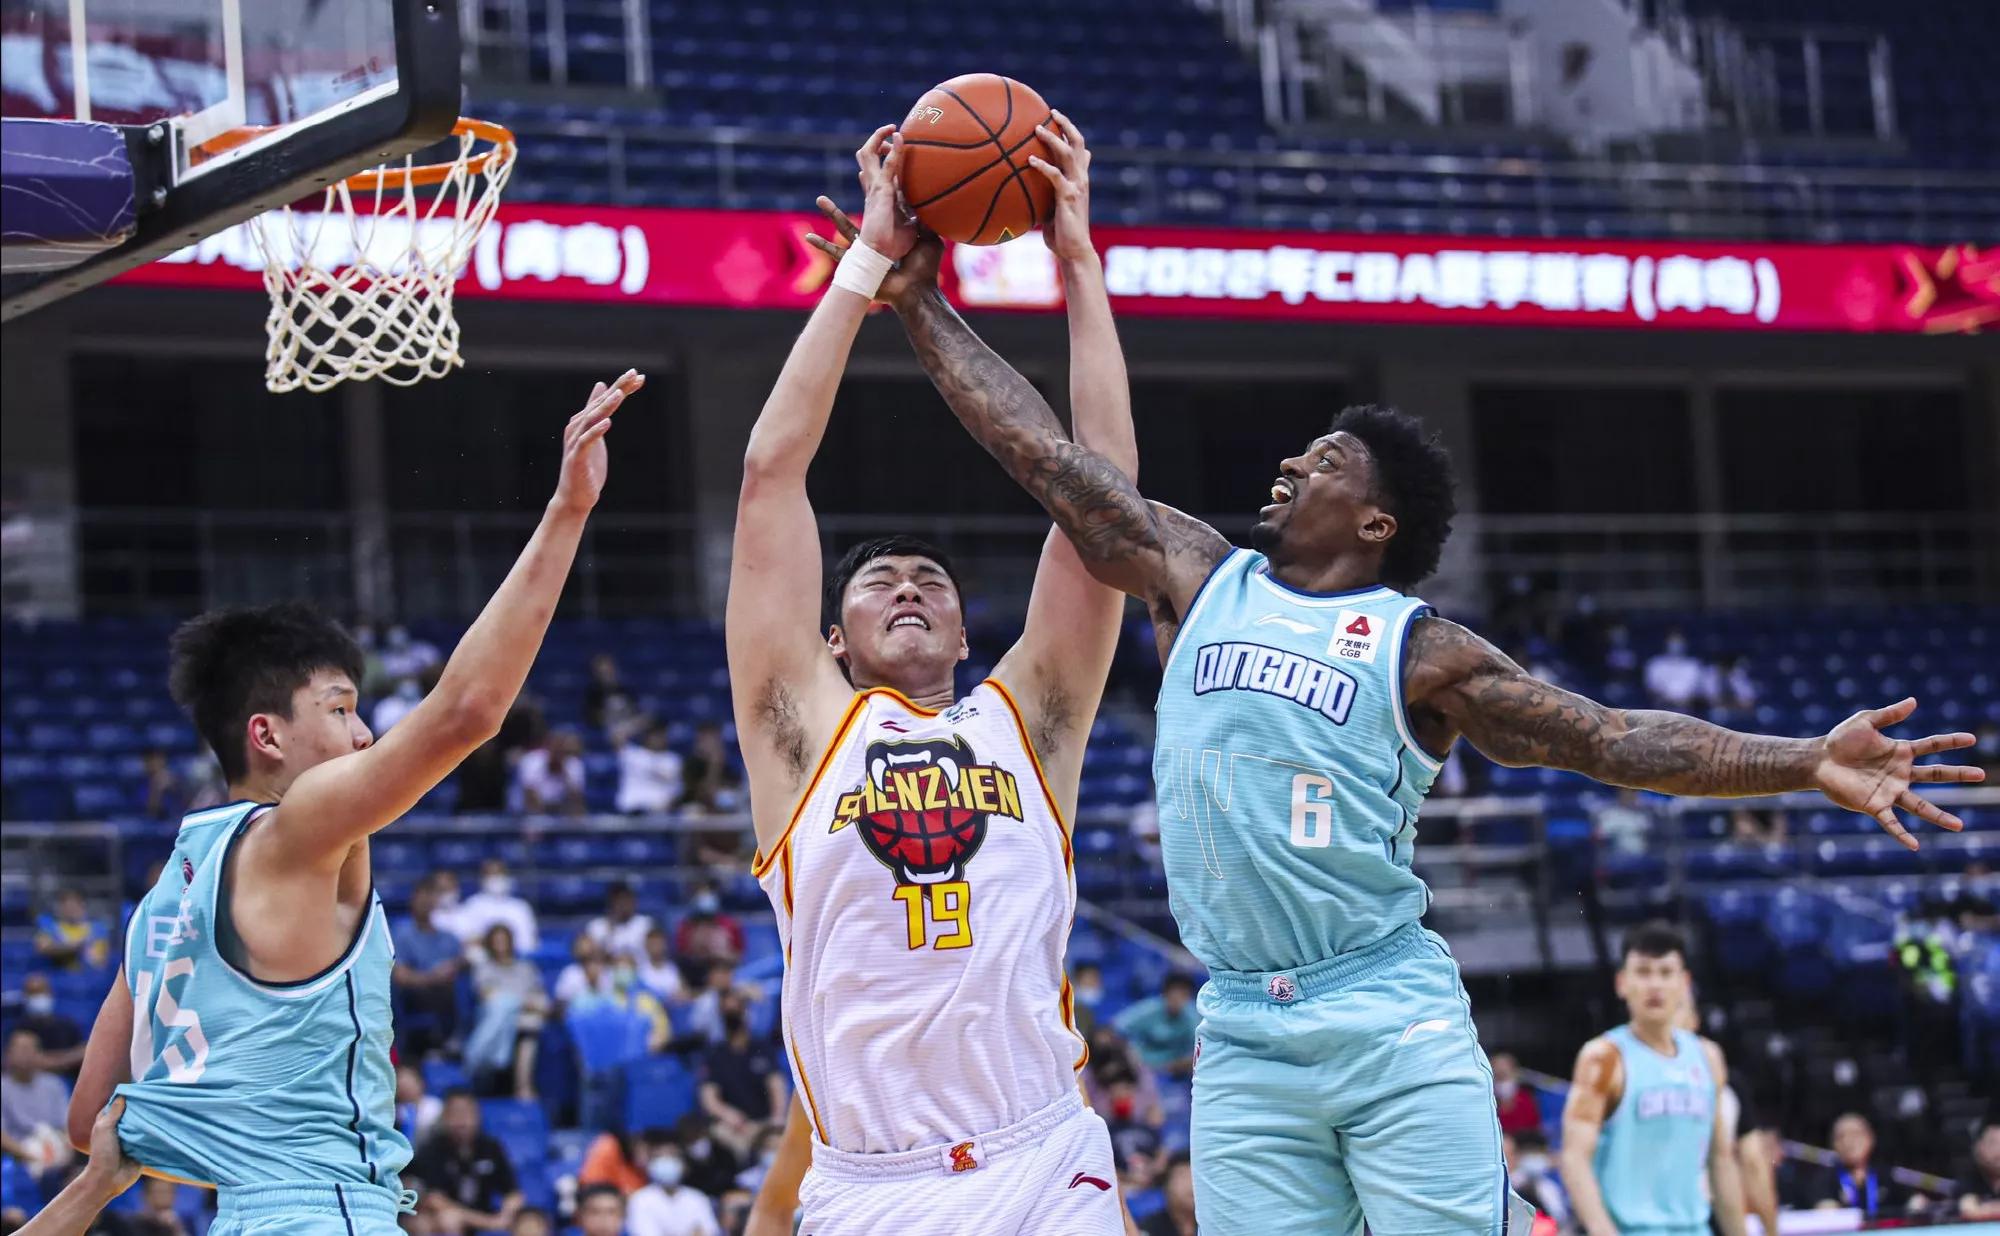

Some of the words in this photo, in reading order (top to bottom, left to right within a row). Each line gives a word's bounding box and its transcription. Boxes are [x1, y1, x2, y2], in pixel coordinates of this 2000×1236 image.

[1336, 638, 1371, 651] 广发银行
[1340, 648, 1361, 658] CGB
[1194, 641, 1358, 726] QINGDAO
[828, 762, 1024, 834] SHENZHEN
[1290, 773, 1333, 848] 6
[892, 880, 973, 950] 19
